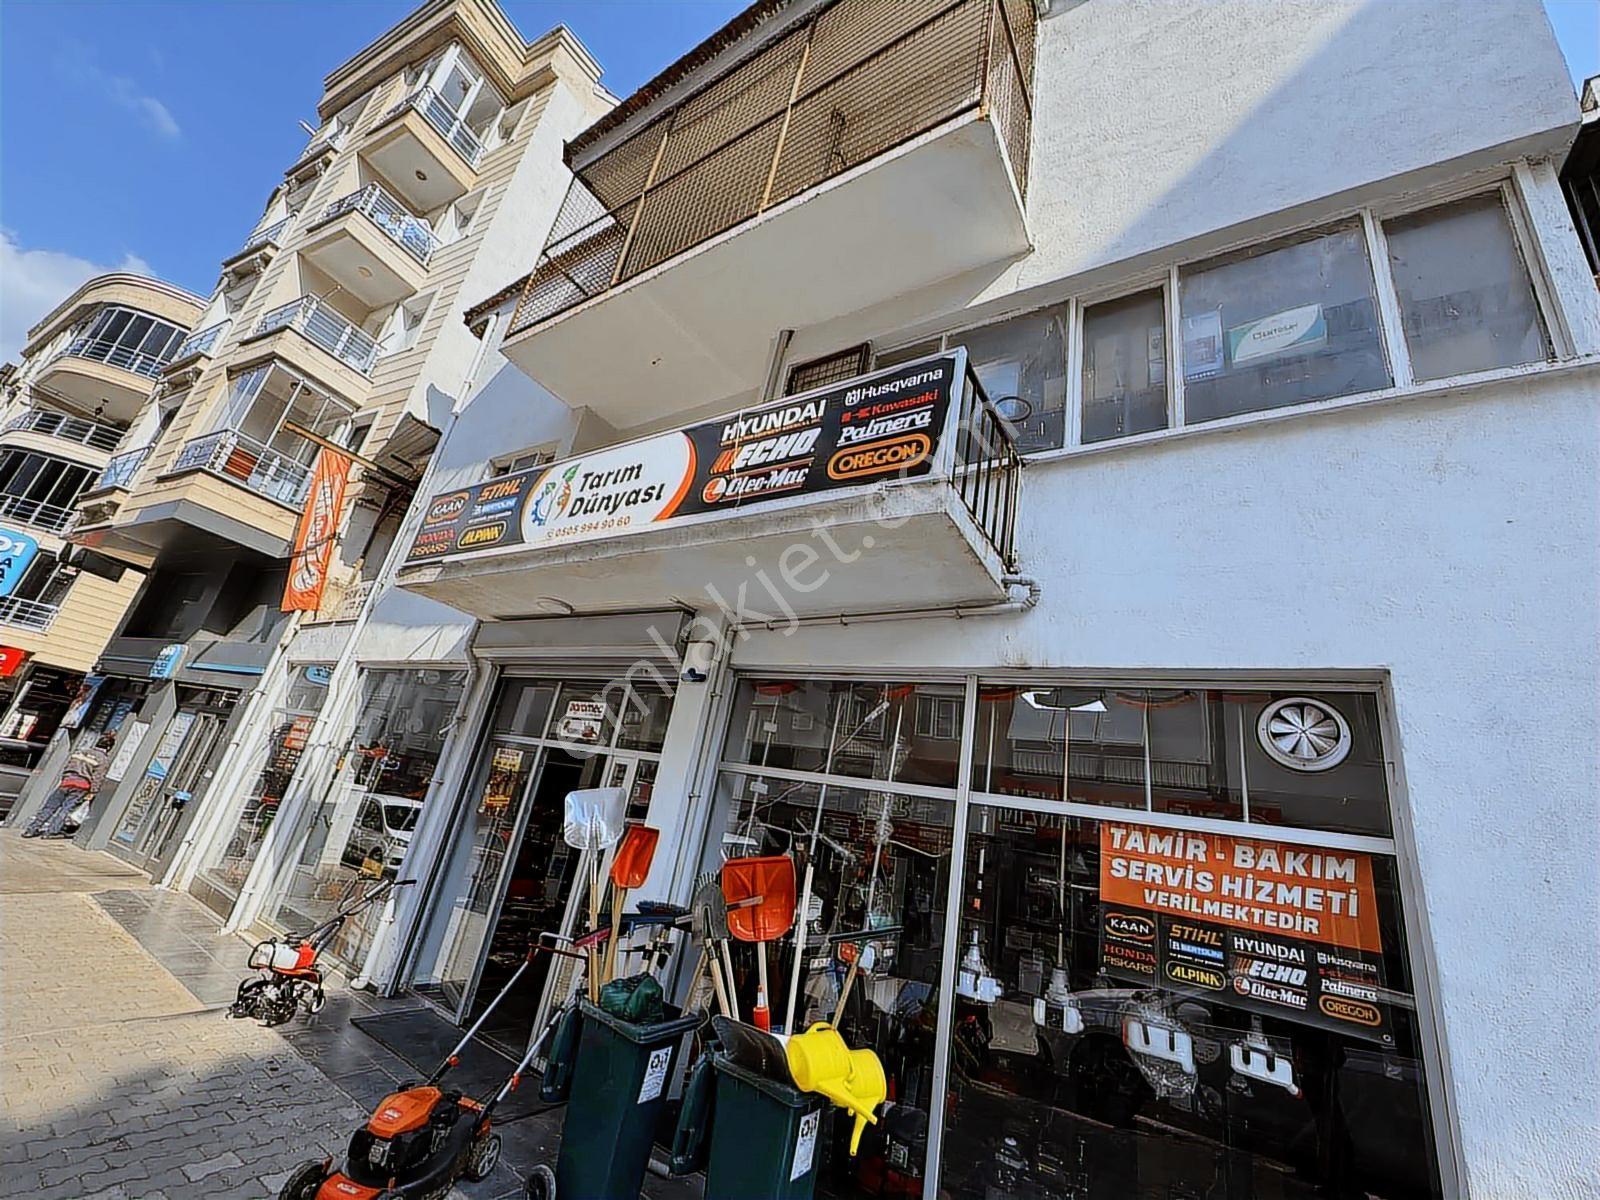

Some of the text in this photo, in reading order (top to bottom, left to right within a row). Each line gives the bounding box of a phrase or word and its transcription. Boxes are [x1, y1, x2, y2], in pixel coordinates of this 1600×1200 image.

[861, 369, 943, 399] Husqvarna
[872, 389, 939, 415] Kawasaki
[722, 399, 826, 441] HYUNDAI
[840, 411, 931, 442] Palmera
[839, 442, 917, 472] OREGON
[478, 479, 520, 501] STIHL
[580, 463, 643, 493] Tarım
[725, 468, 809, 496] Oleo-Mac
[431, 499, 464, 517] KAAN
[568, 483, 665, 518] Dünyası
[616, 516, 631, 527] 60
[1109, 827, 1208, 863] TAMİR
[1233, 844, 1356, 883] BAKIM
[1110, 858, 1359, 917] SERVİS HİZMETİ
[1144, 888, 1320, 935] VERİLMEKTEDİR
[1110, 918, 1149, 934] KAAN
[1169, 924, 1222, 946] STIHL
[1104, 944, 1156, 964] HONDA
[1233, 936, 1306, 963] HYUNDAI
[1103, 955, 1155, 974] FISKARS
[1328, 953, 1377, 973] Husqvarna
[1172, 966, 1221, 986] ALPINA
[1251, 983, 1308, 1007] Oleo-Mac
[1321, 978, 1378, 1002] Palmera
[1326, 1001, 1374, 1020] OREGON
